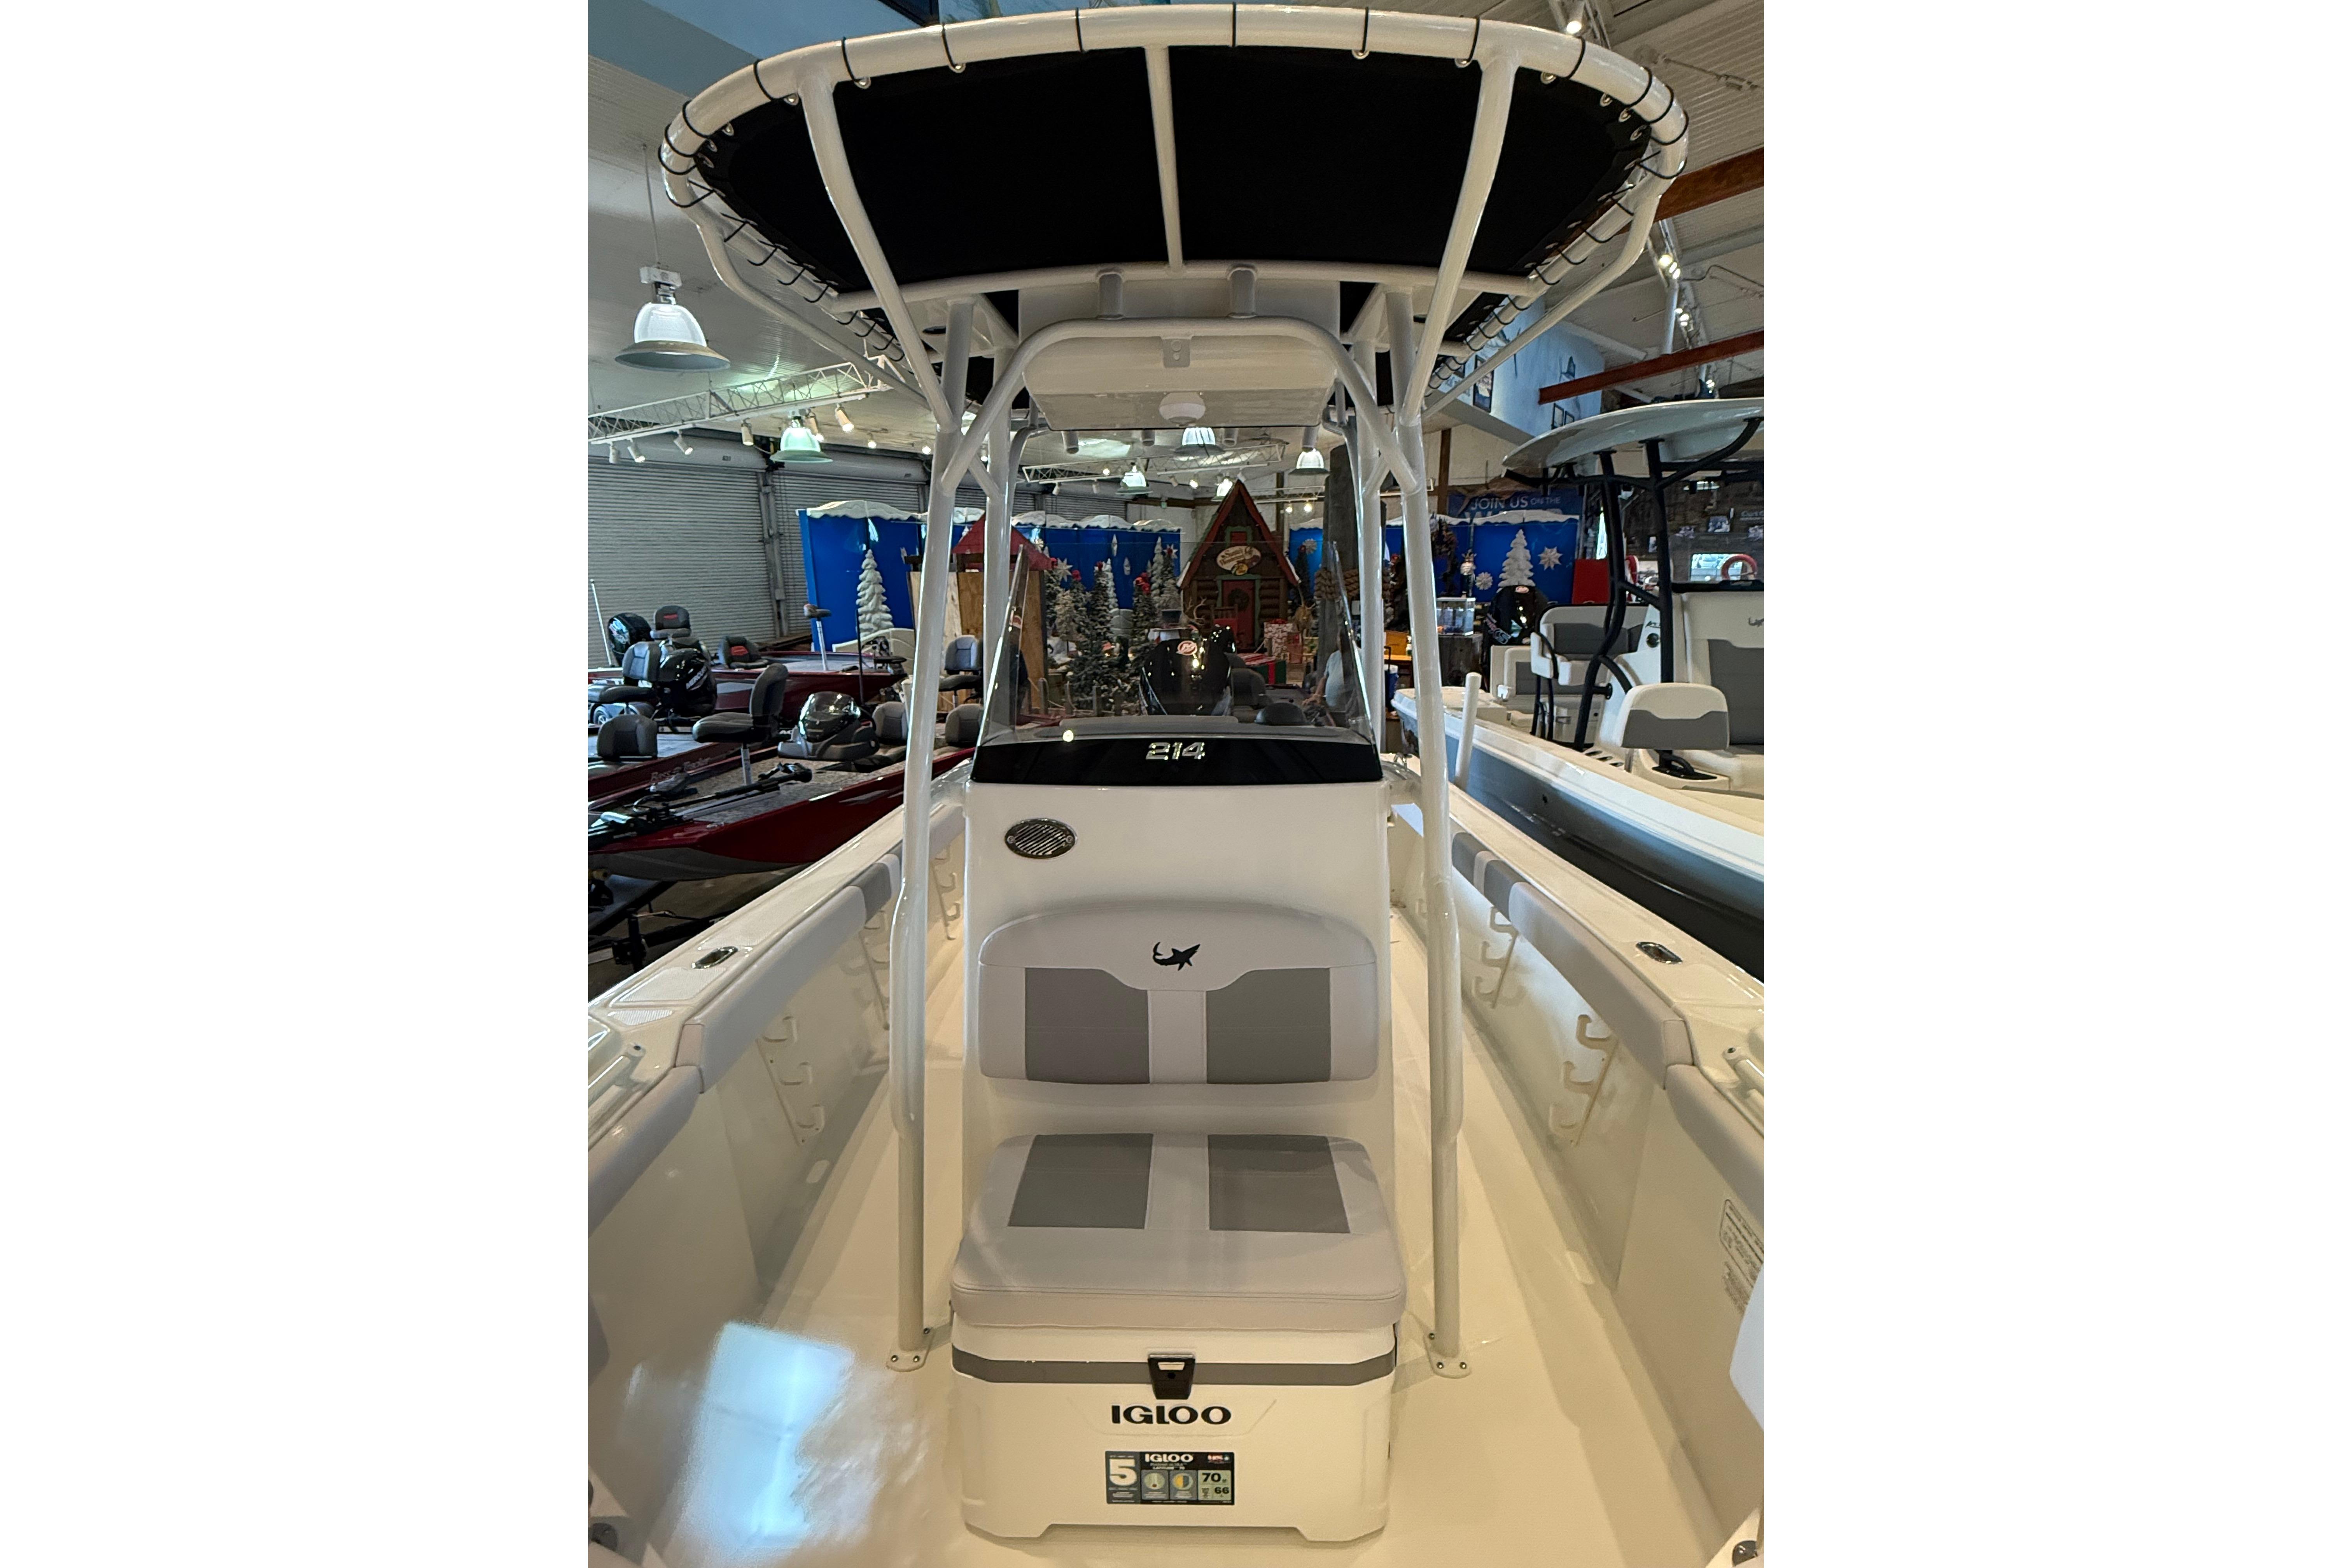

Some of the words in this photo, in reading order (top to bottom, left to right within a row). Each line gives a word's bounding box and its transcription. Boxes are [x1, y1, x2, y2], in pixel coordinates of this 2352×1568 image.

[1470, 497, 1505, 510] JOIN
[1509, 496, 1528, 508] US
[1146, 742, 1205, 760] 214
[1111, 1405, 1232, 1425] IGLOO
[1145, 1454, 1194, 1462] IGLOO
[1109, 1459, 1137, 1486] 5
[1202, 1473, 1221, 1482] 70
